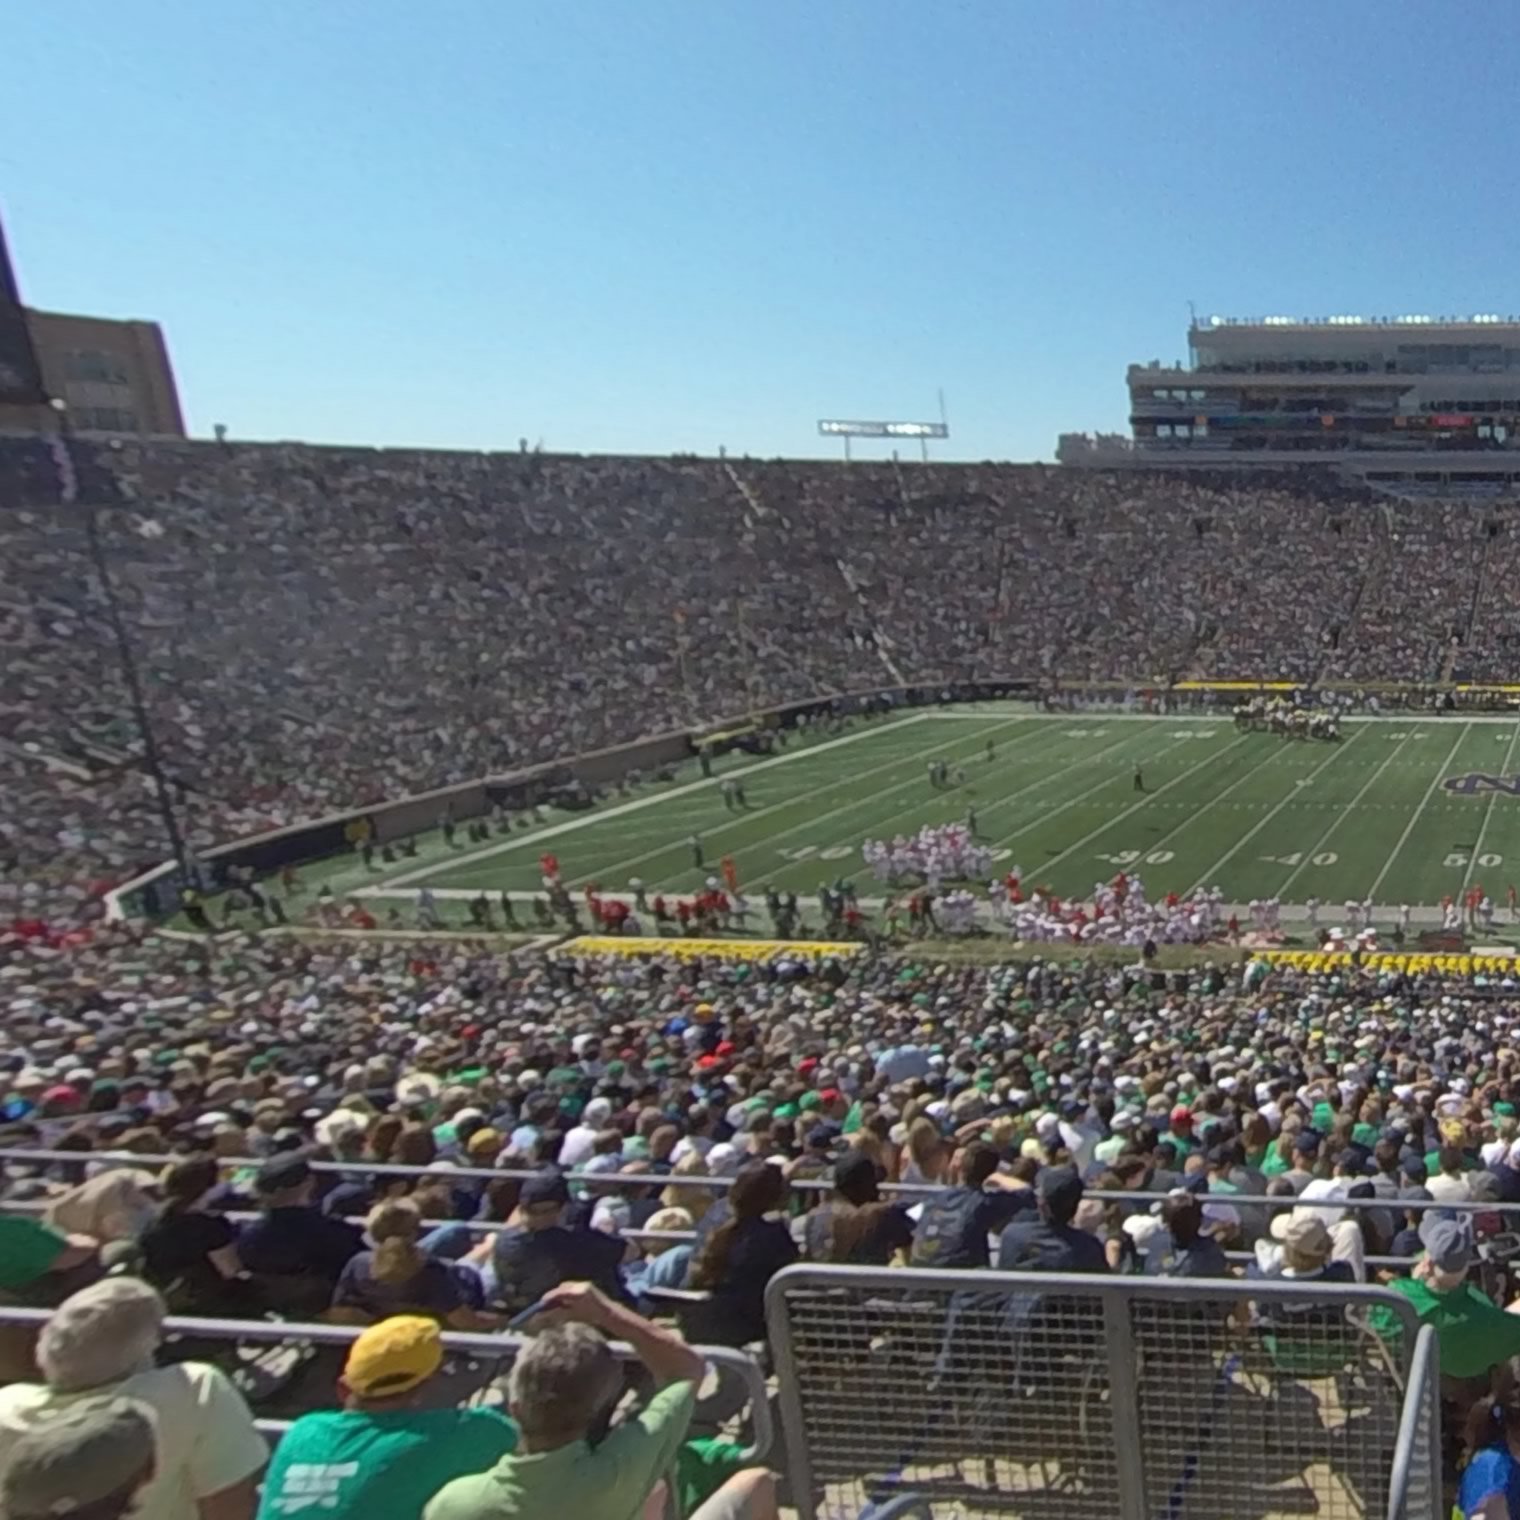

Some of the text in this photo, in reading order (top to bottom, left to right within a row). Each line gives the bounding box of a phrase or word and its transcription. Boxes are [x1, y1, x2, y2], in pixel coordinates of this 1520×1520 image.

[1110, 850, 1175, 864] 30
[1276, 852, 1338, 865] 40
[1443, 853, 1503, 867] 50
